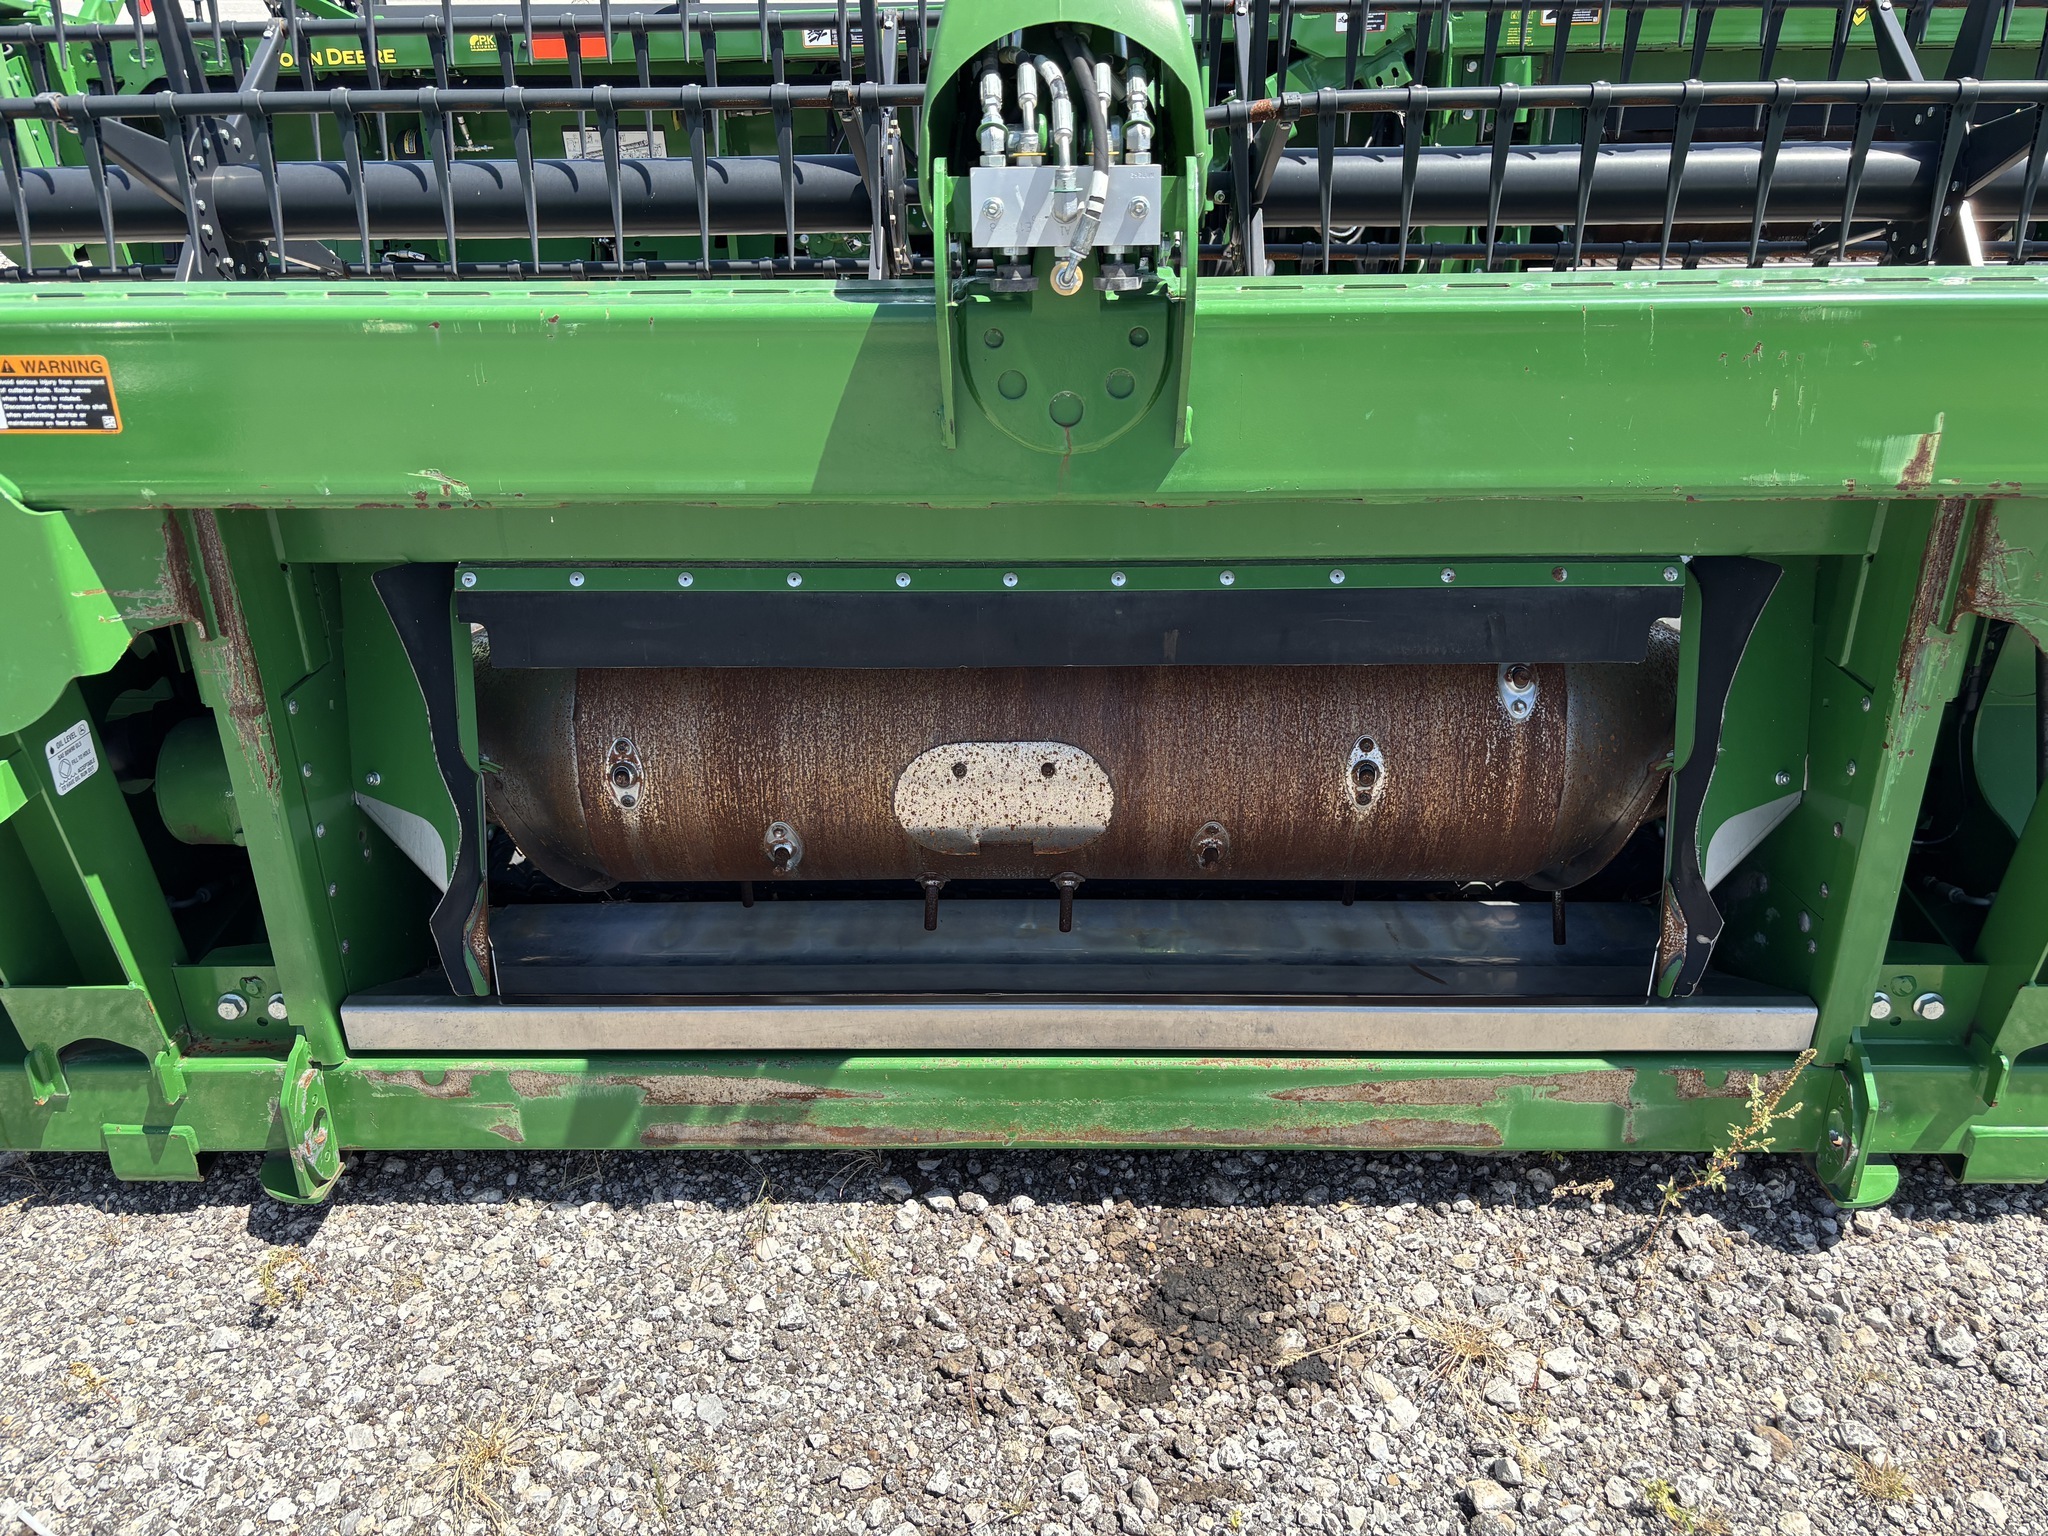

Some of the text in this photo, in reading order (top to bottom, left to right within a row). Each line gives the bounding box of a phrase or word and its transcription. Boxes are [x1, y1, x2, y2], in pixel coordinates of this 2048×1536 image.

[20, 360, 103, 373] WARNING
[56, 732, 77, 749] OIL LEVEL
[71, 757, 79, 765] FILL
[82, 748, 91, 758] HOLE
[78, 758, 95, 773] ACCEPTABLE
